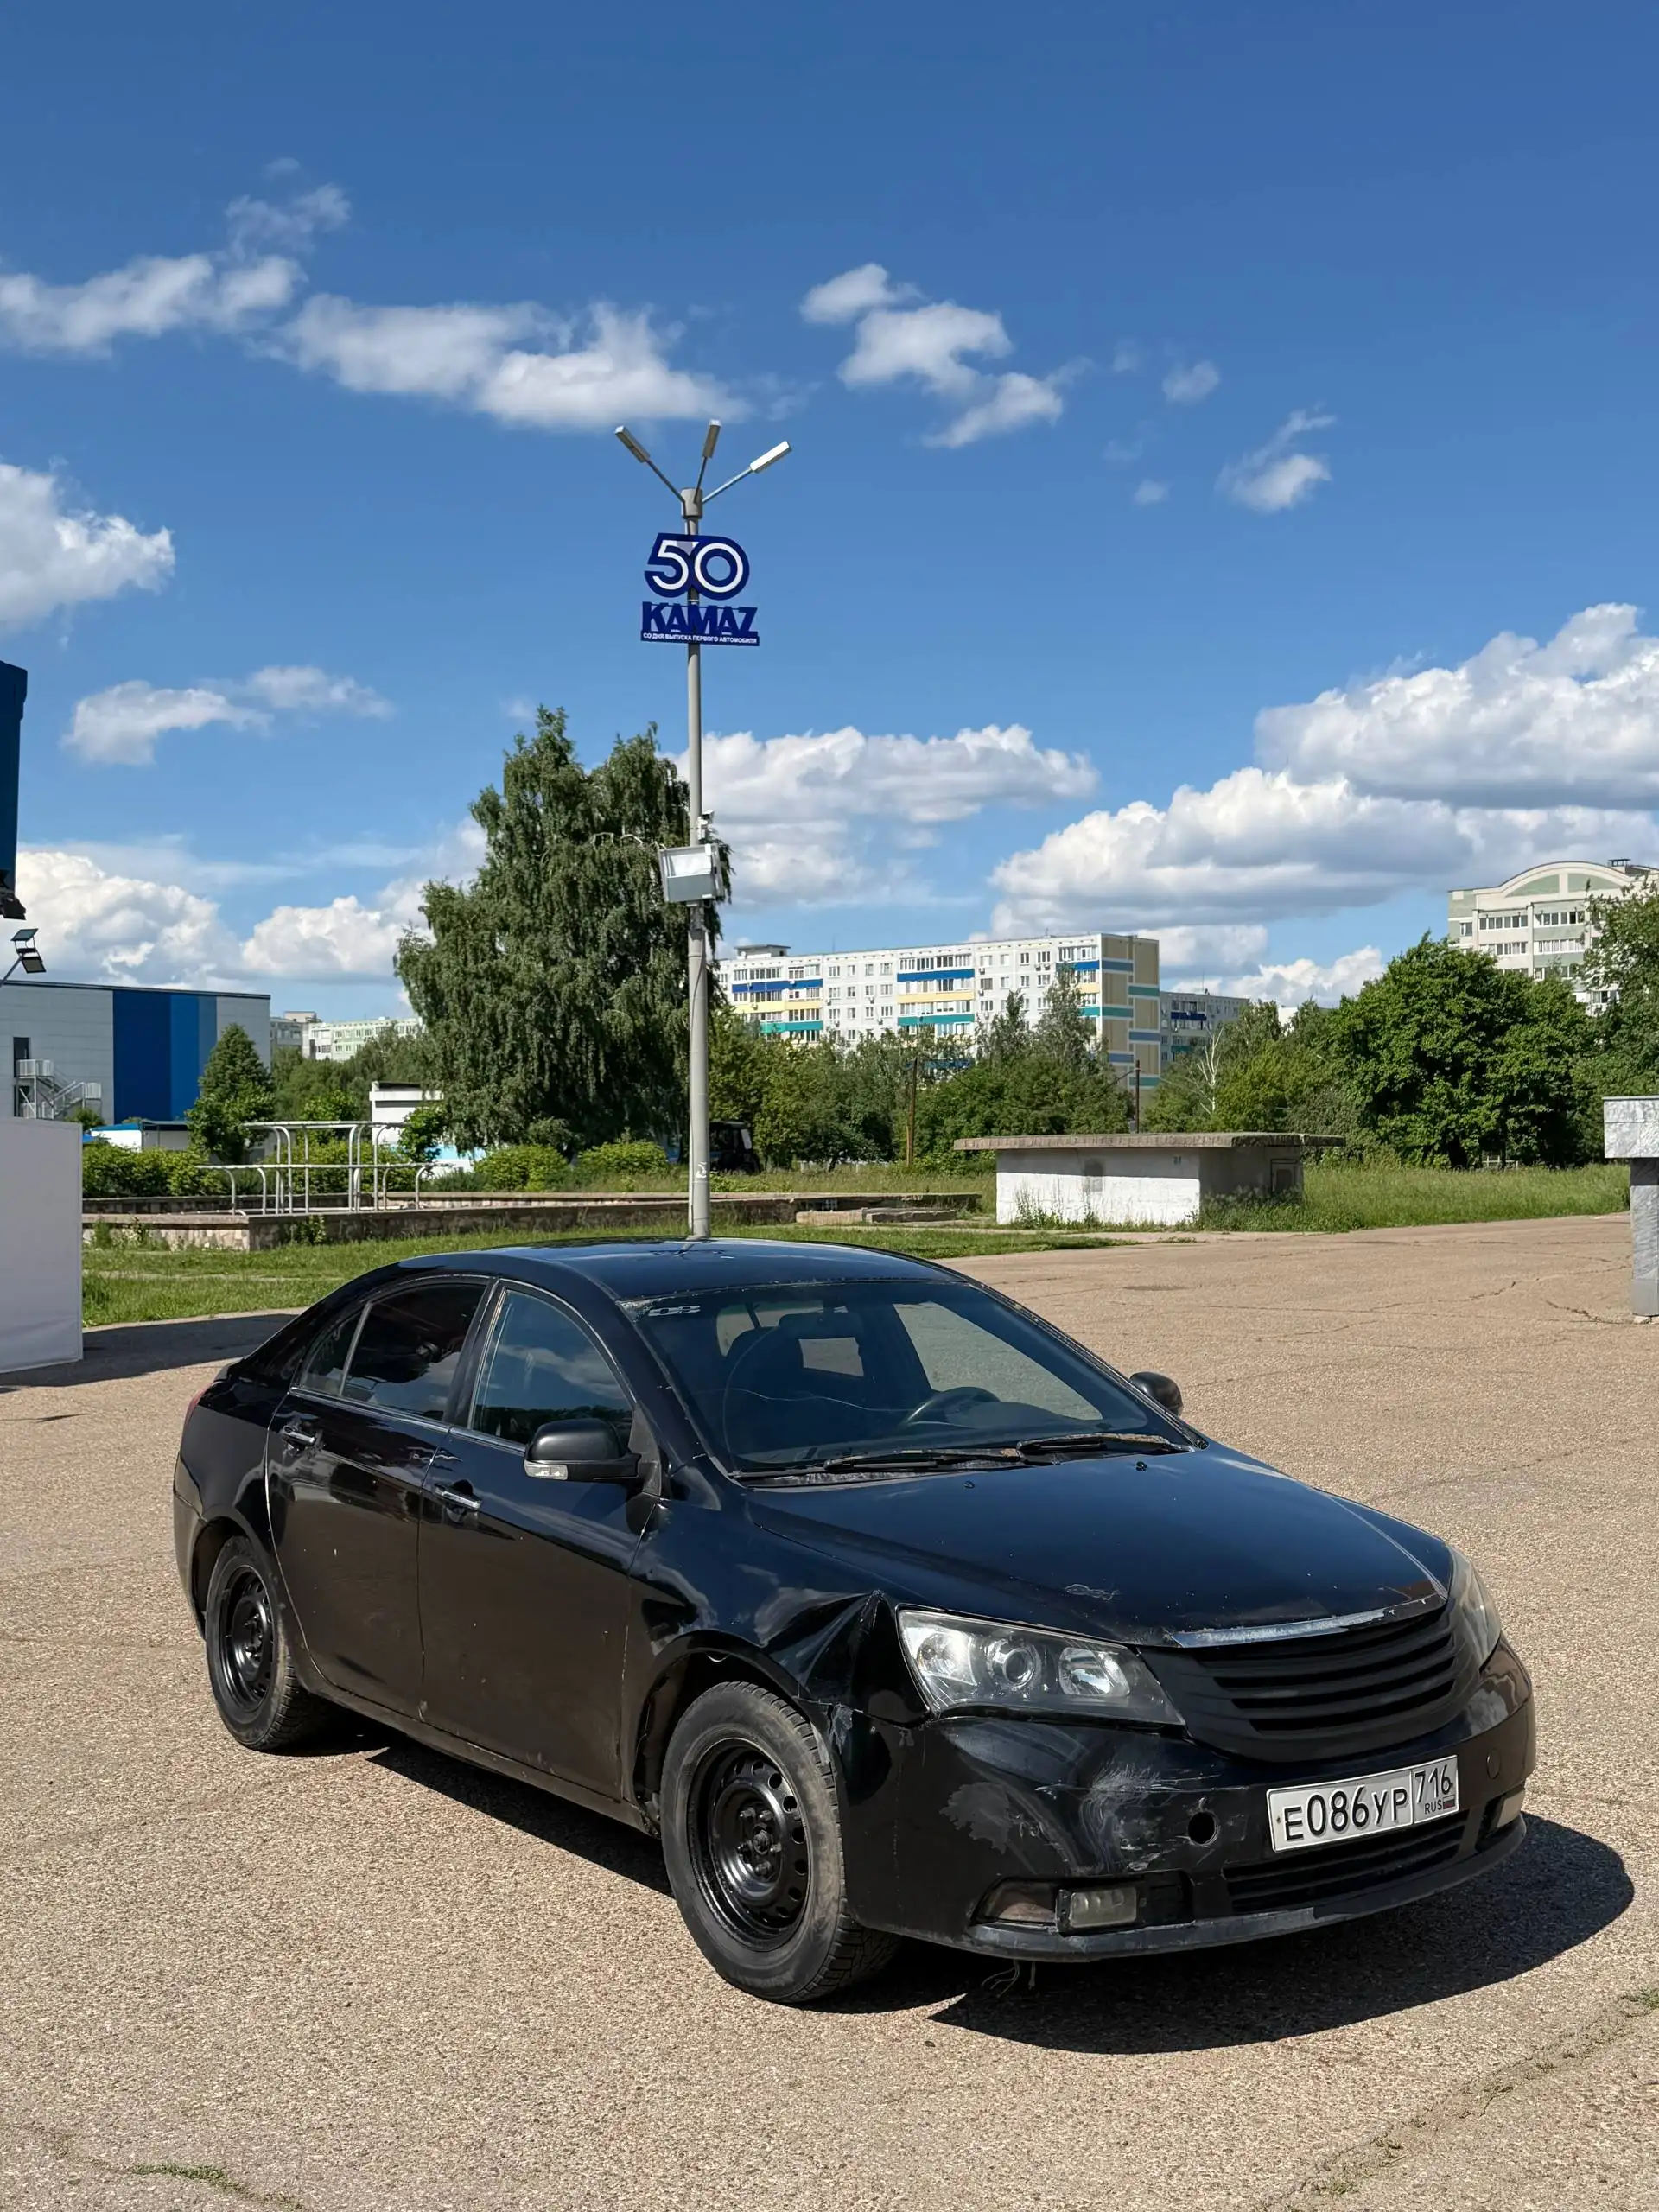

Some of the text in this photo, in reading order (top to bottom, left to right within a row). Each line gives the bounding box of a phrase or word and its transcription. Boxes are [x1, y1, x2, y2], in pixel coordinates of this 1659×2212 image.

[650, 539, 744, 594] 50
[642, 602, 759, 636] KAMAZ
[1414, 1764, 1453, 1804] 716
[1425, 1799, 1443, 1815] RUS
